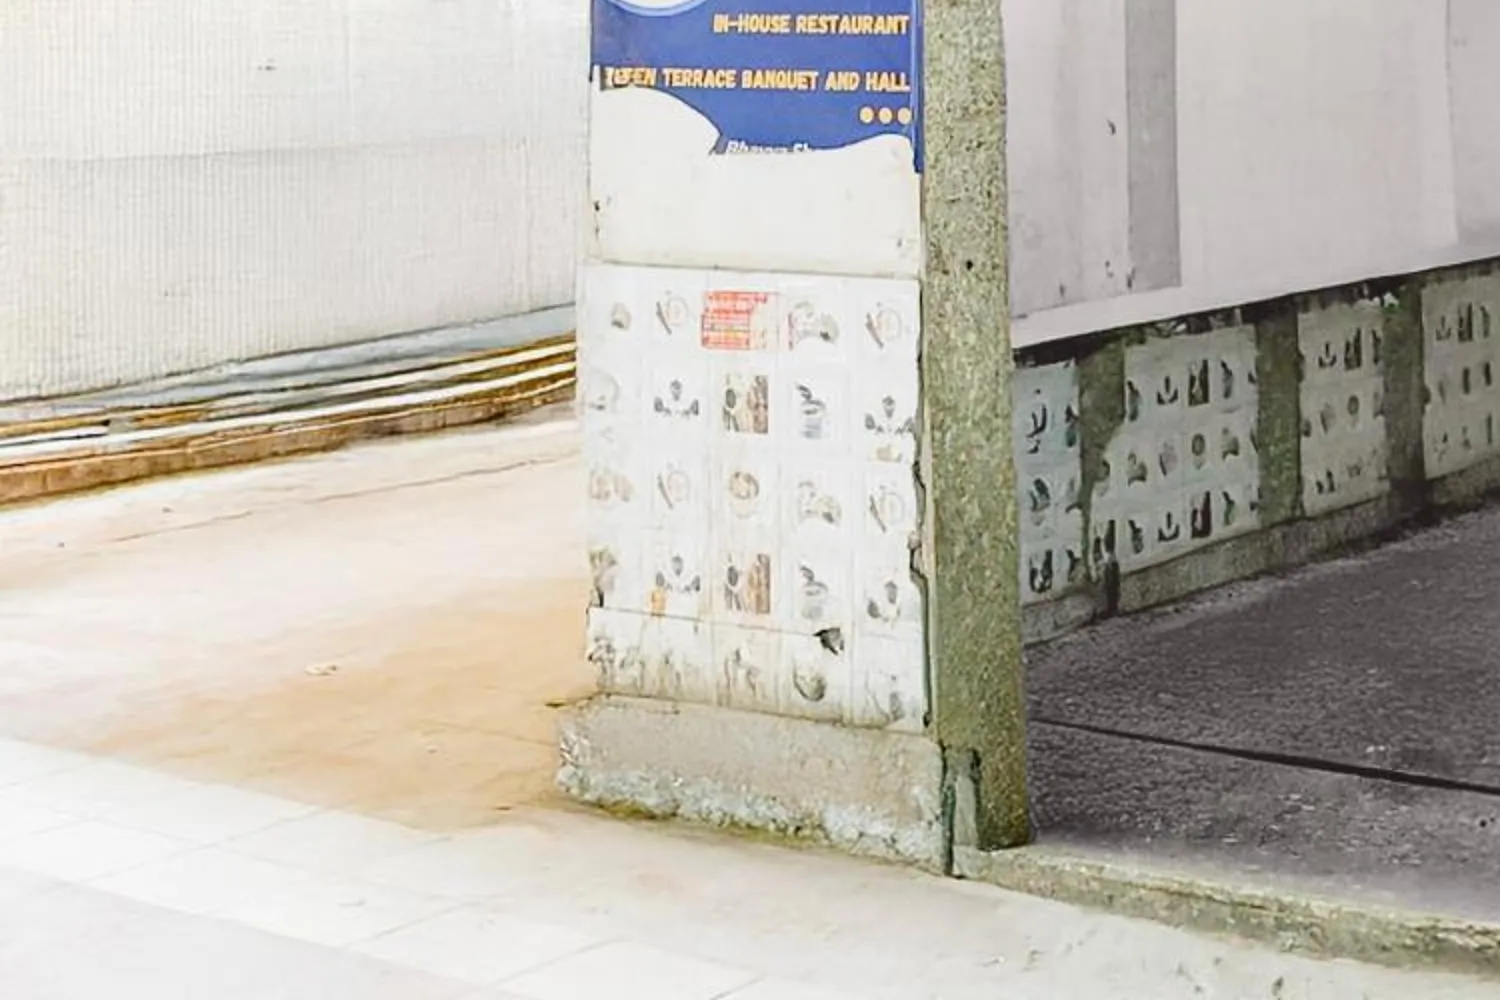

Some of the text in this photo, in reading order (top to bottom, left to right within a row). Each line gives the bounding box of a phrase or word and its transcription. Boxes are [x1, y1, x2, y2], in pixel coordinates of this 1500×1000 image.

[713, 13, 910, 36] IN-HOUSE RESTAURANT
[662, 67, 736, 89] TERRACE
[741, 68, 819, 91] BANQUET
[825, 71, 860, 91] AND
[865, 70, 911, 93] HALL
